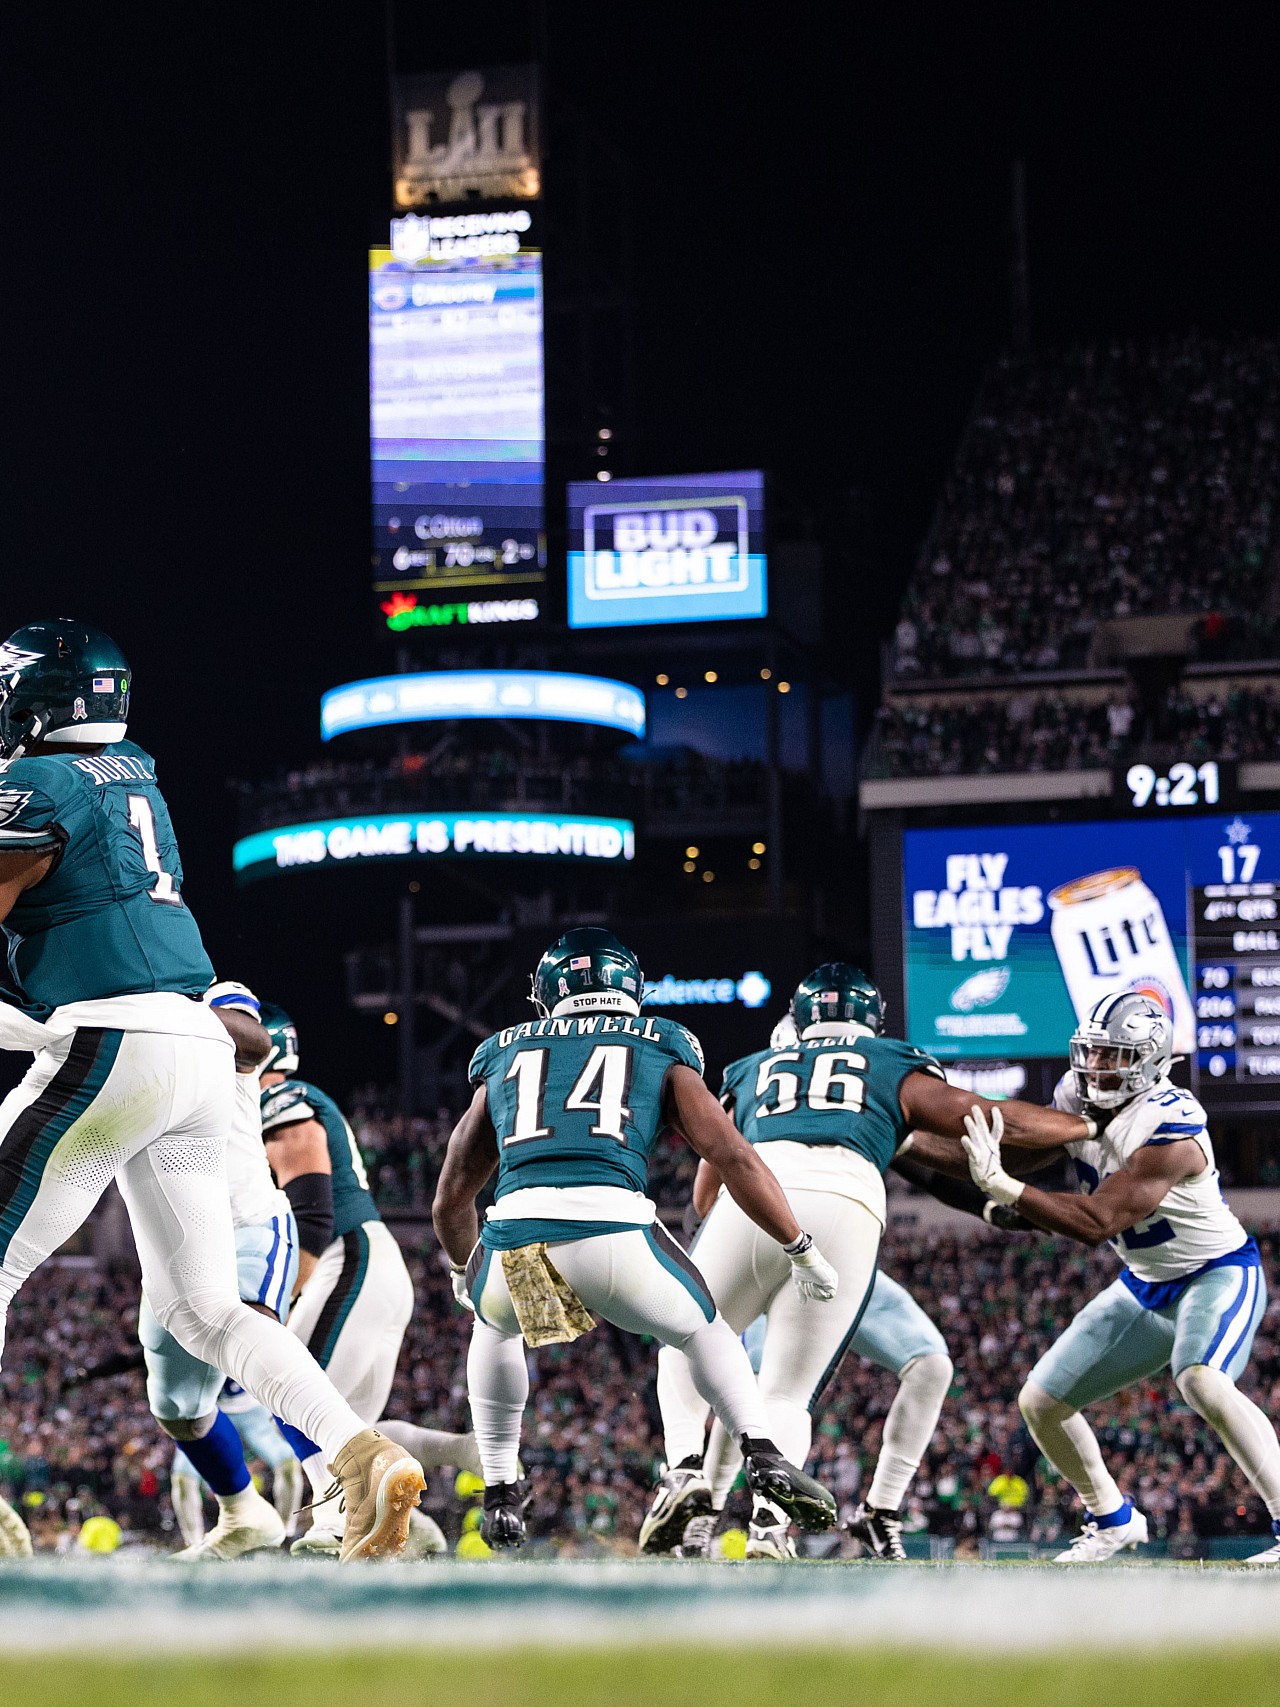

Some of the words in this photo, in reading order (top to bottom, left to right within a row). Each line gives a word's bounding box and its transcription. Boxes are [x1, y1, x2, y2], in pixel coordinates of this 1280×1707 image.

[613, 508, 719, 552] BUD
[595, 541, 737, 590] LIGHT
[1126, 761, 1220, 807] 9:21
[127, 794, 183, 908] 1
[272, 829, 327, 868] THIS
[327, 822, 413, 860] GAME
[416, 820, 449, 854] IS
[453, 820, 624, 860] PRESENTED
[1218, 844, 1261, 884] 17
[946, 852, 1009, 892] FLY
[913, 885, 1045, 928] EAGLES
[951, 924, 1014, 961] FLY
[1079, 912, 1157, 977] Lite
[573, 997, 597, 1007] STOP
[600, 997, 622, 1006] HATE
[498, 1016, 661, 1049] GAINWELL
[503, 1044, 634, 1148] 14
[755, 1051, 867, 1119] 56
